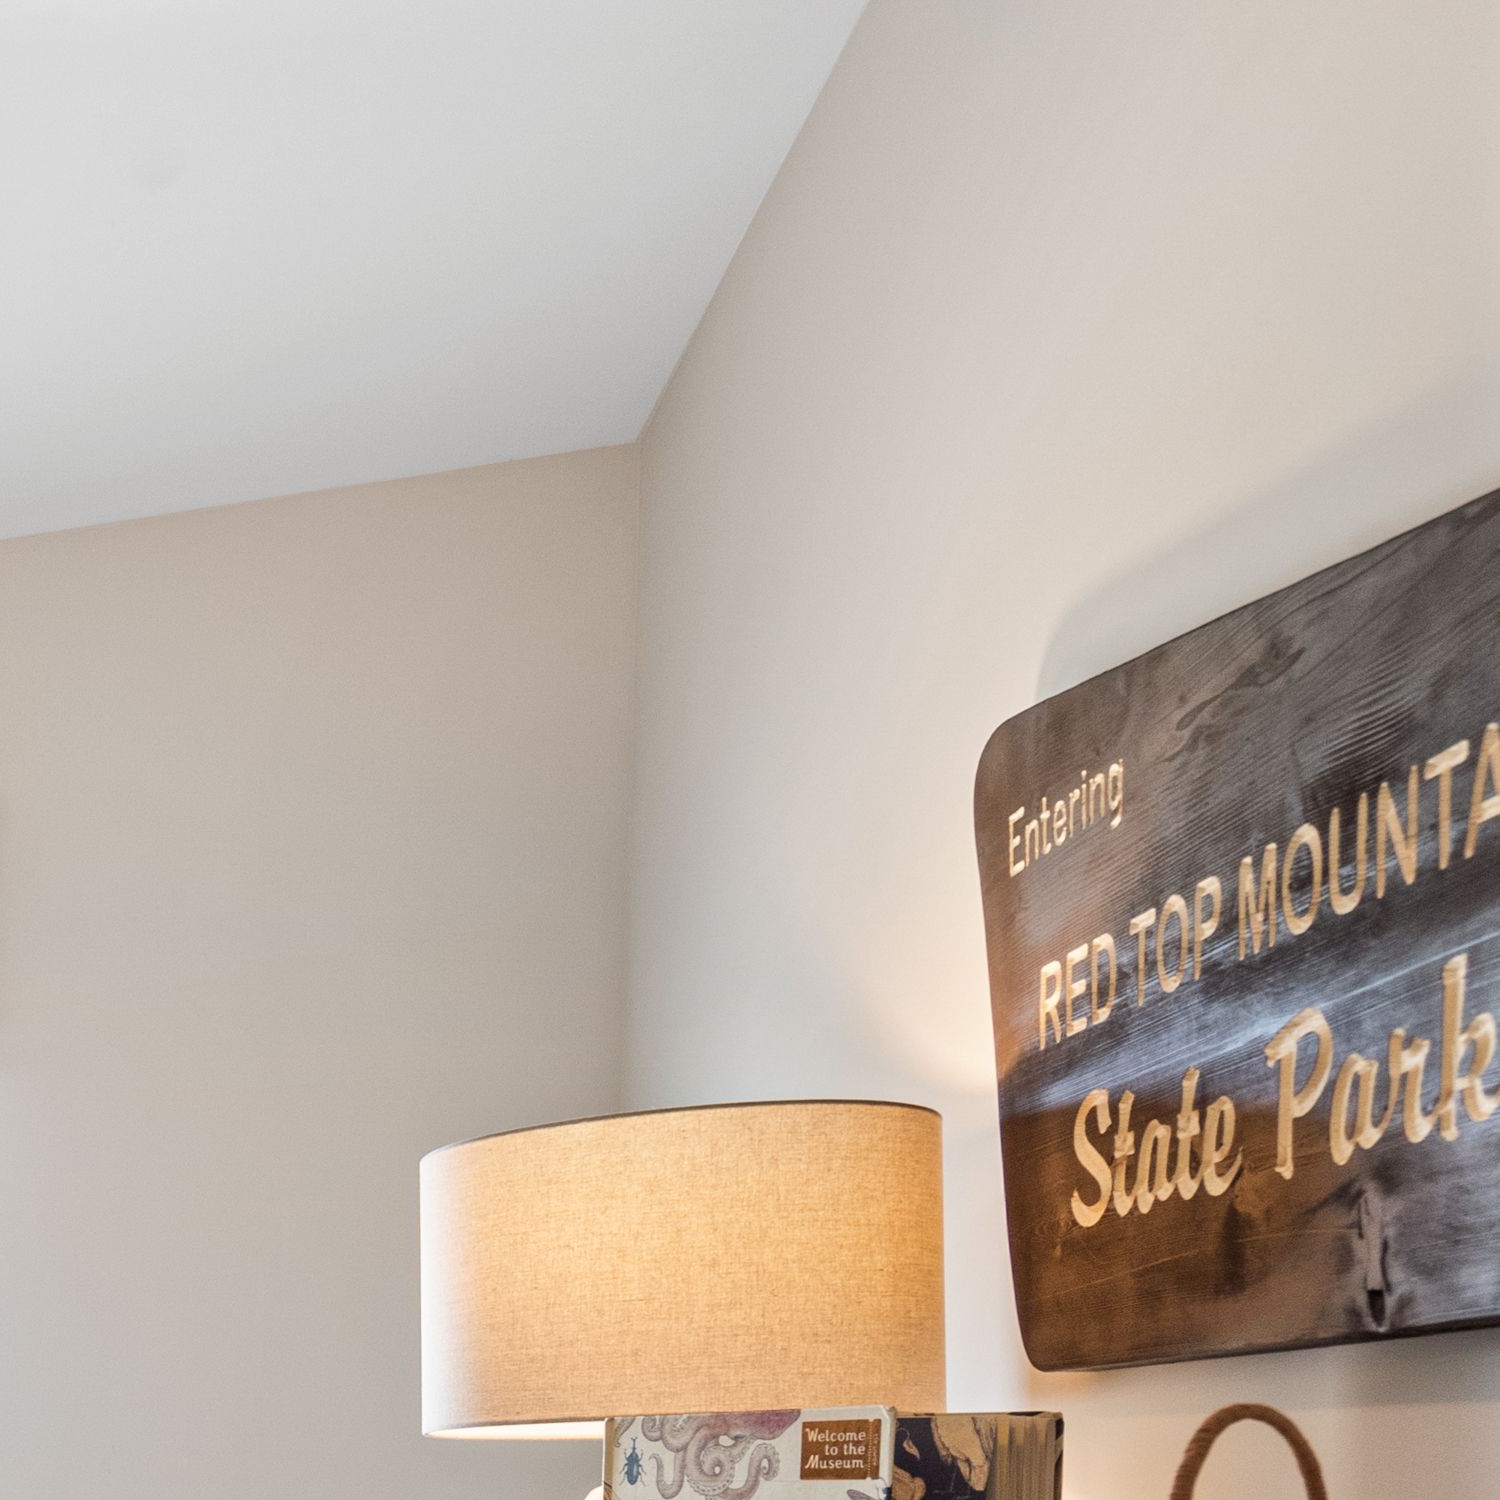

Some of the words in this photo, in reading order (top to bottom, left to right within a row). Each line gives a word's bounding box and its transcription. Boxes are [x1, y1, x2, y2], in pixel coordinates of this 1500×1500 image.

[1008, 758, 1124, 878] Entering
[1039, 960, 1118, 1051] RED
[1128, 875, 1222, 1007] TOP
[1238, 722, 1500, 961] MOUNTA
[1070, 1065, 1244, 1228] State
[1264, 952, 1500, 1181] Park
[804, 1454, 864, 1470] Museum
[805, 1427, 867, 1443] Welcome
[824, 1443, 838, 1456] to
[843, 1443, 866, 1456] the
